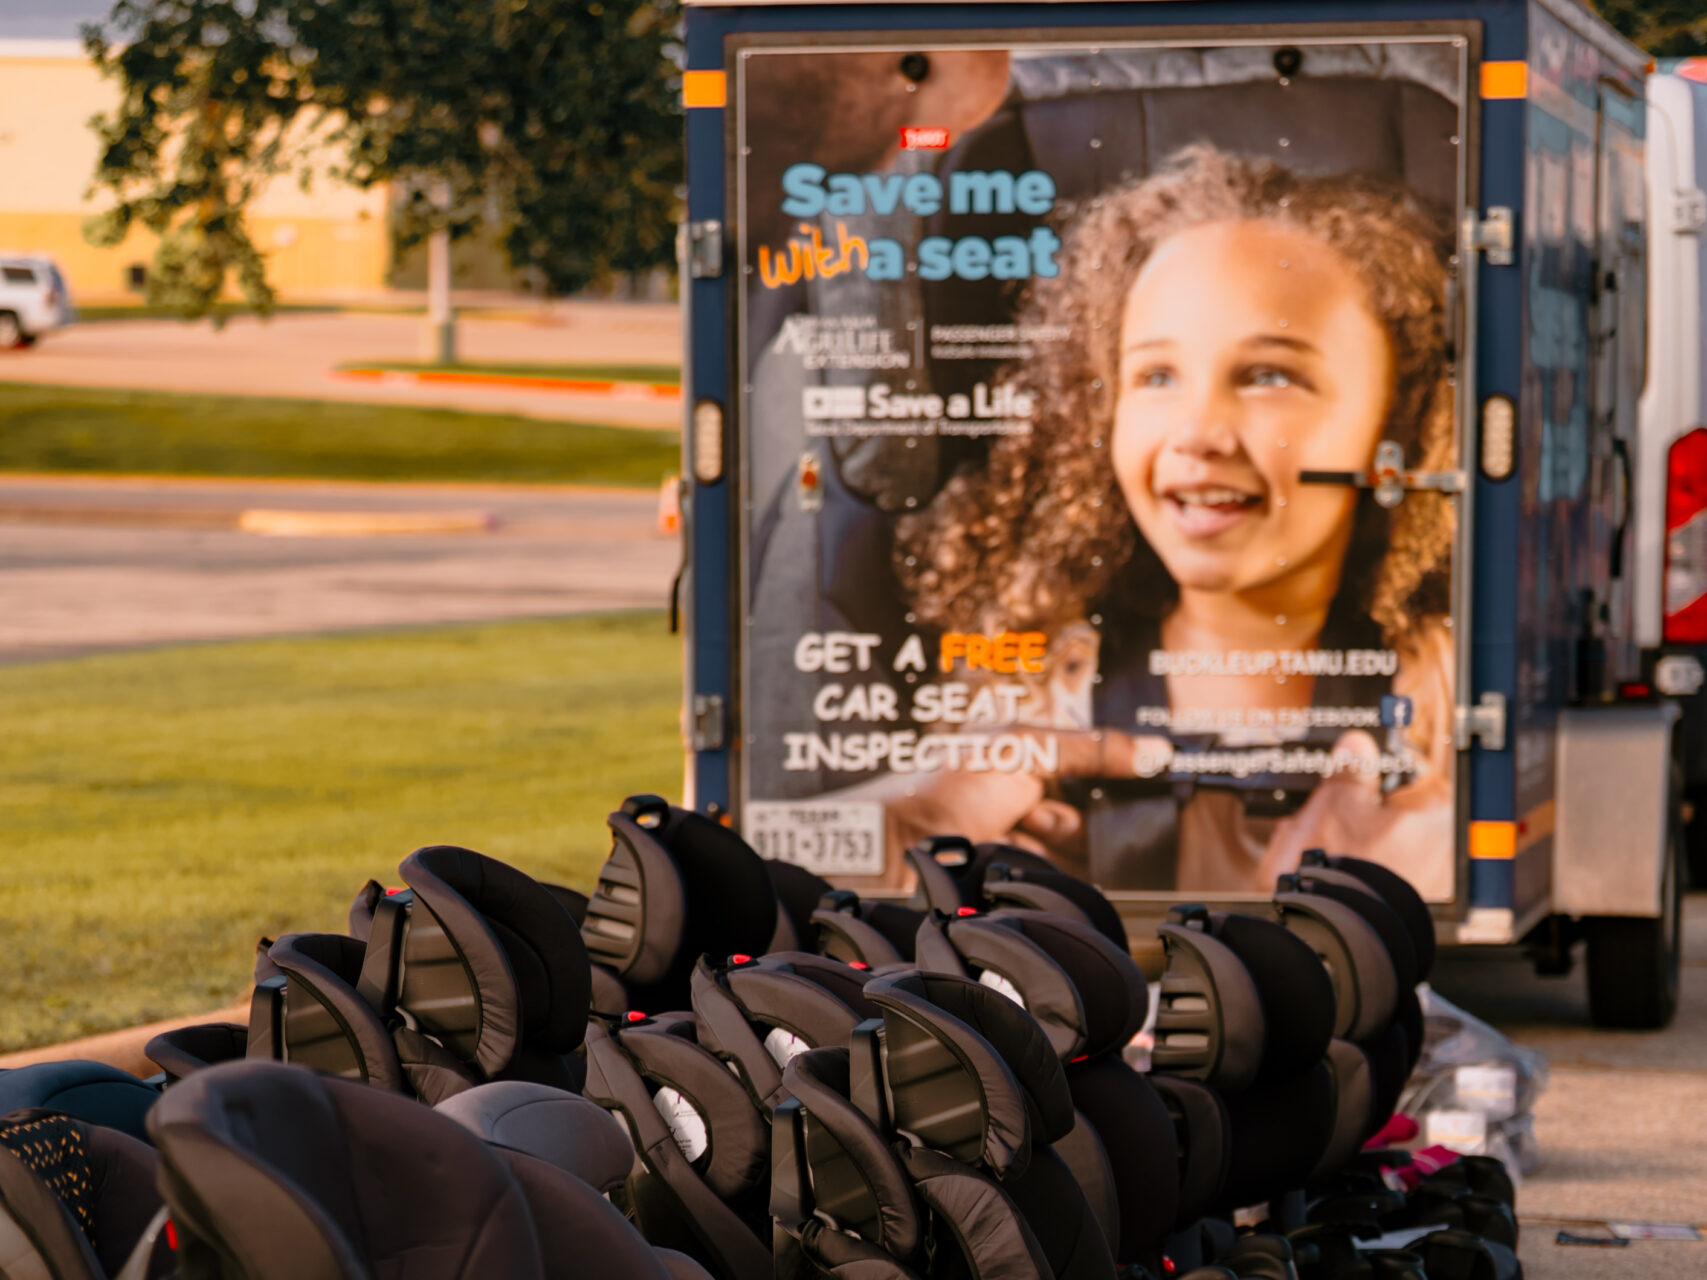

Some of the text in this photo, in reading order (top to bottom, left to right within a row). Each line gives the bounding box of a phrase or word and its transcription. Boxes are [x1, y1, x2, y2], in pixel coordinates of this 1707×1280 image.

[781, 162, 1056, 217] Save me
[759, 221, 1061, 289] with a seat
[868, 382, 1034, 418] Save a Life
[794, 631, 1047, 673] GET A FREE
[814, 682, 1026, 723] CAR SEAT
[1278, 706, 1380, 727] FACEBOOK
[783, 732, 1058, 773] INSPECTION
